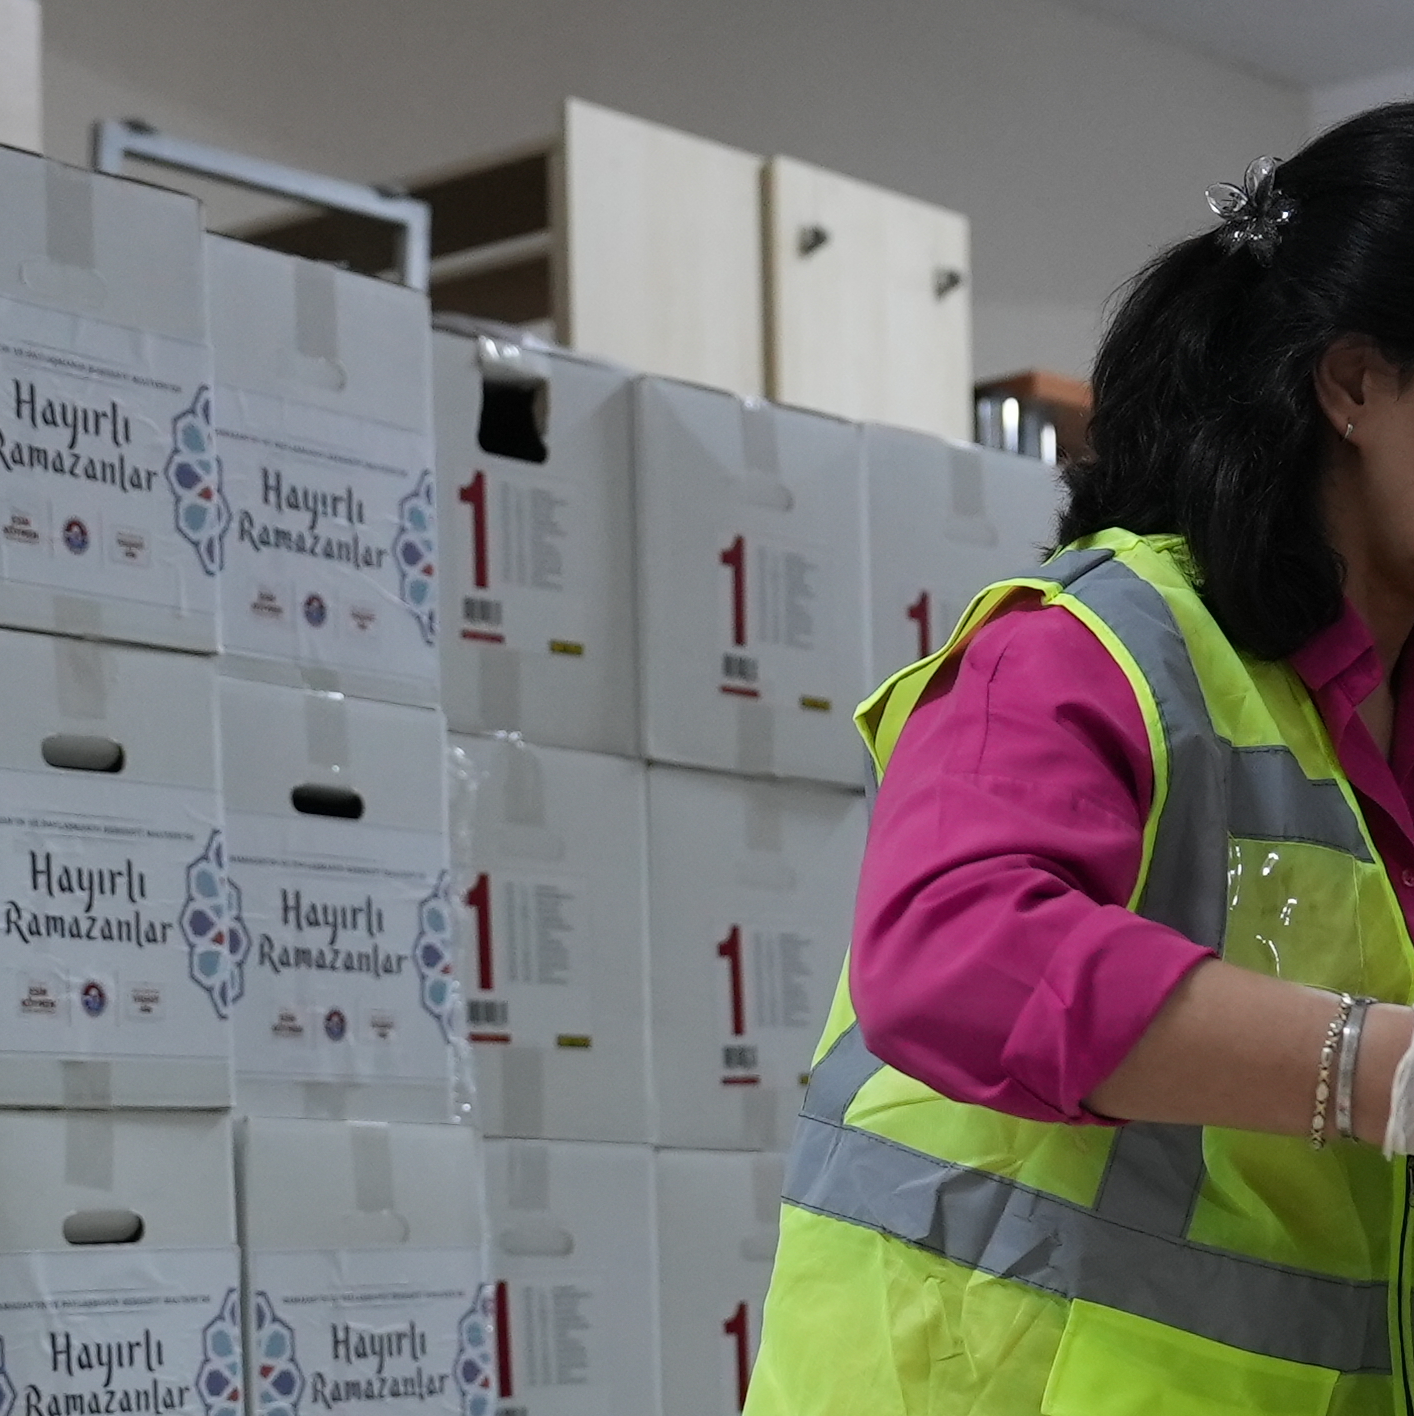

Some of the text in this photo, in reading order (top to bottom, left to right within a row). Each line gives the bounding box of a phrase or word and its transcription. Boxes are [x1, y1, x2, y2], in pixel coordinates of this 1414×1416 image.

[13, 377, 132, 449] Hayırlı
[261, 466, 365, 530] Hayırlı
[239, 509, 387, 570] Ramazanlar
[30, 850, 147, 913] Hayırlı
[5, 900, 174, 947] Ramazanlar
[281, 888, 385, 946] Hayırlı
[258, 933, 408, 979] Ramazanlar
[50, 1328, 164, 1388] Hayırlı
[331, 1320, 427, 1374] Hayırlı
[311, 1367, 449, 1410] Ramazanlar
